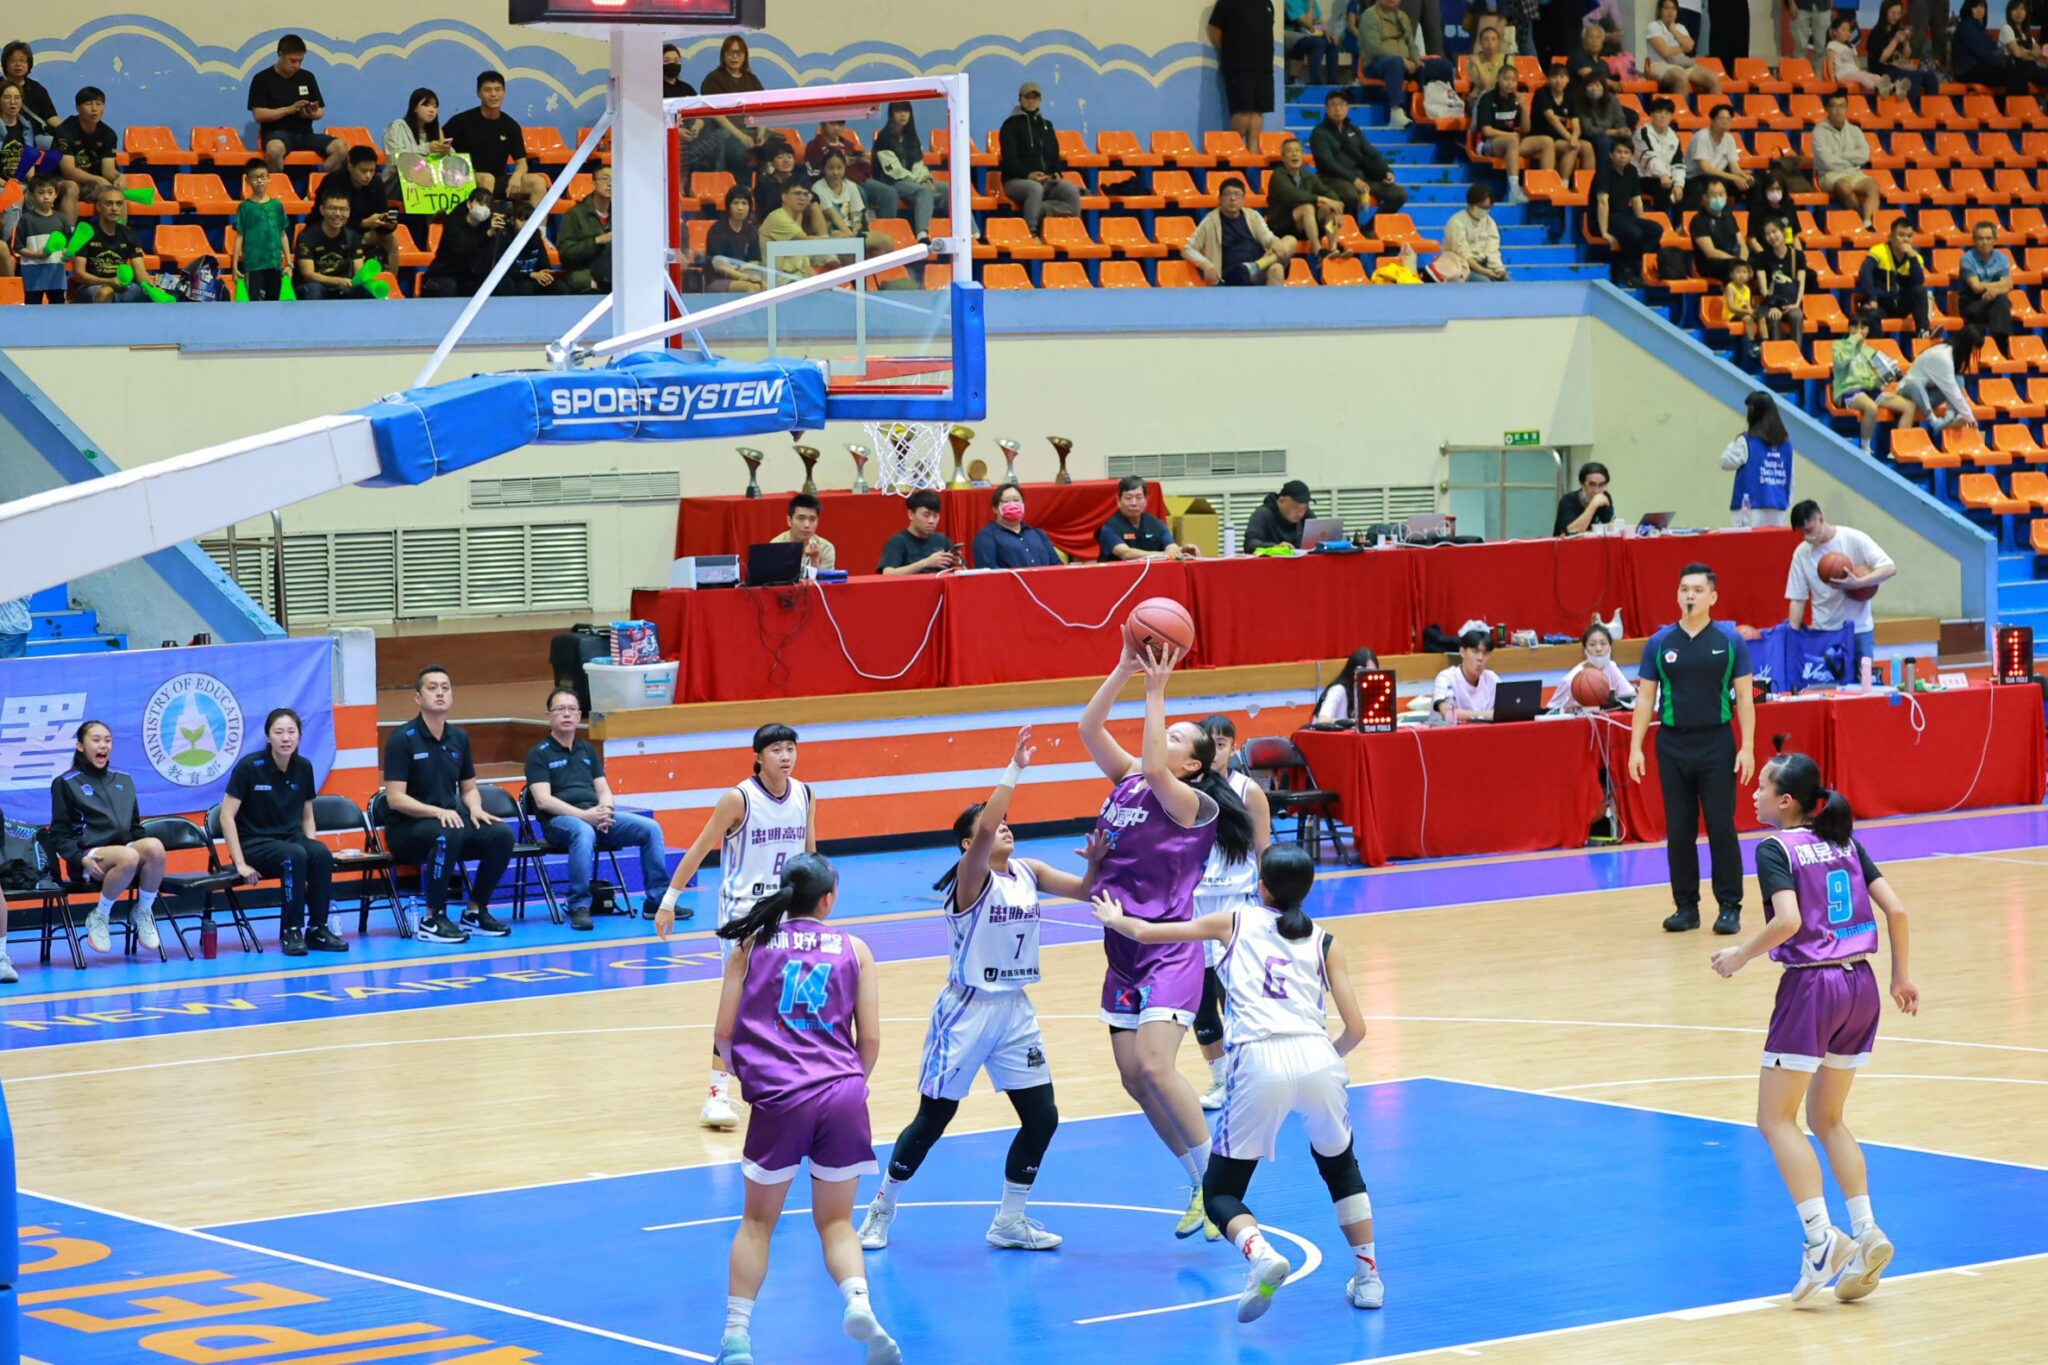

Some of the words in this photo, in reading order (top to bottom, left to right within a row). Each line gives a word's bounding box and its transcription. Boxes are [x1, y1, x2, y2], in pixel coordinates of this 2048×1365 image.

[2008, 630, 2024, 677] 1
[146, 688, 171, 765] MINISTRY
[172, 677, 192, 694] OF
[195, 677, 240, 757] EDUCATION
[1362, 674, 1391, 724] 2
[167, 760, 221, 785] 教育部
[773, 852, 786, 876] 8
[1826, 868, 1853, 924] 9
[1014, 933, 1025, 960] 7
[1, 998, 258, 1031] NEW
[271, 967, 594, 1001] TAIPEI
[779, 960, 832, 1014] 14
